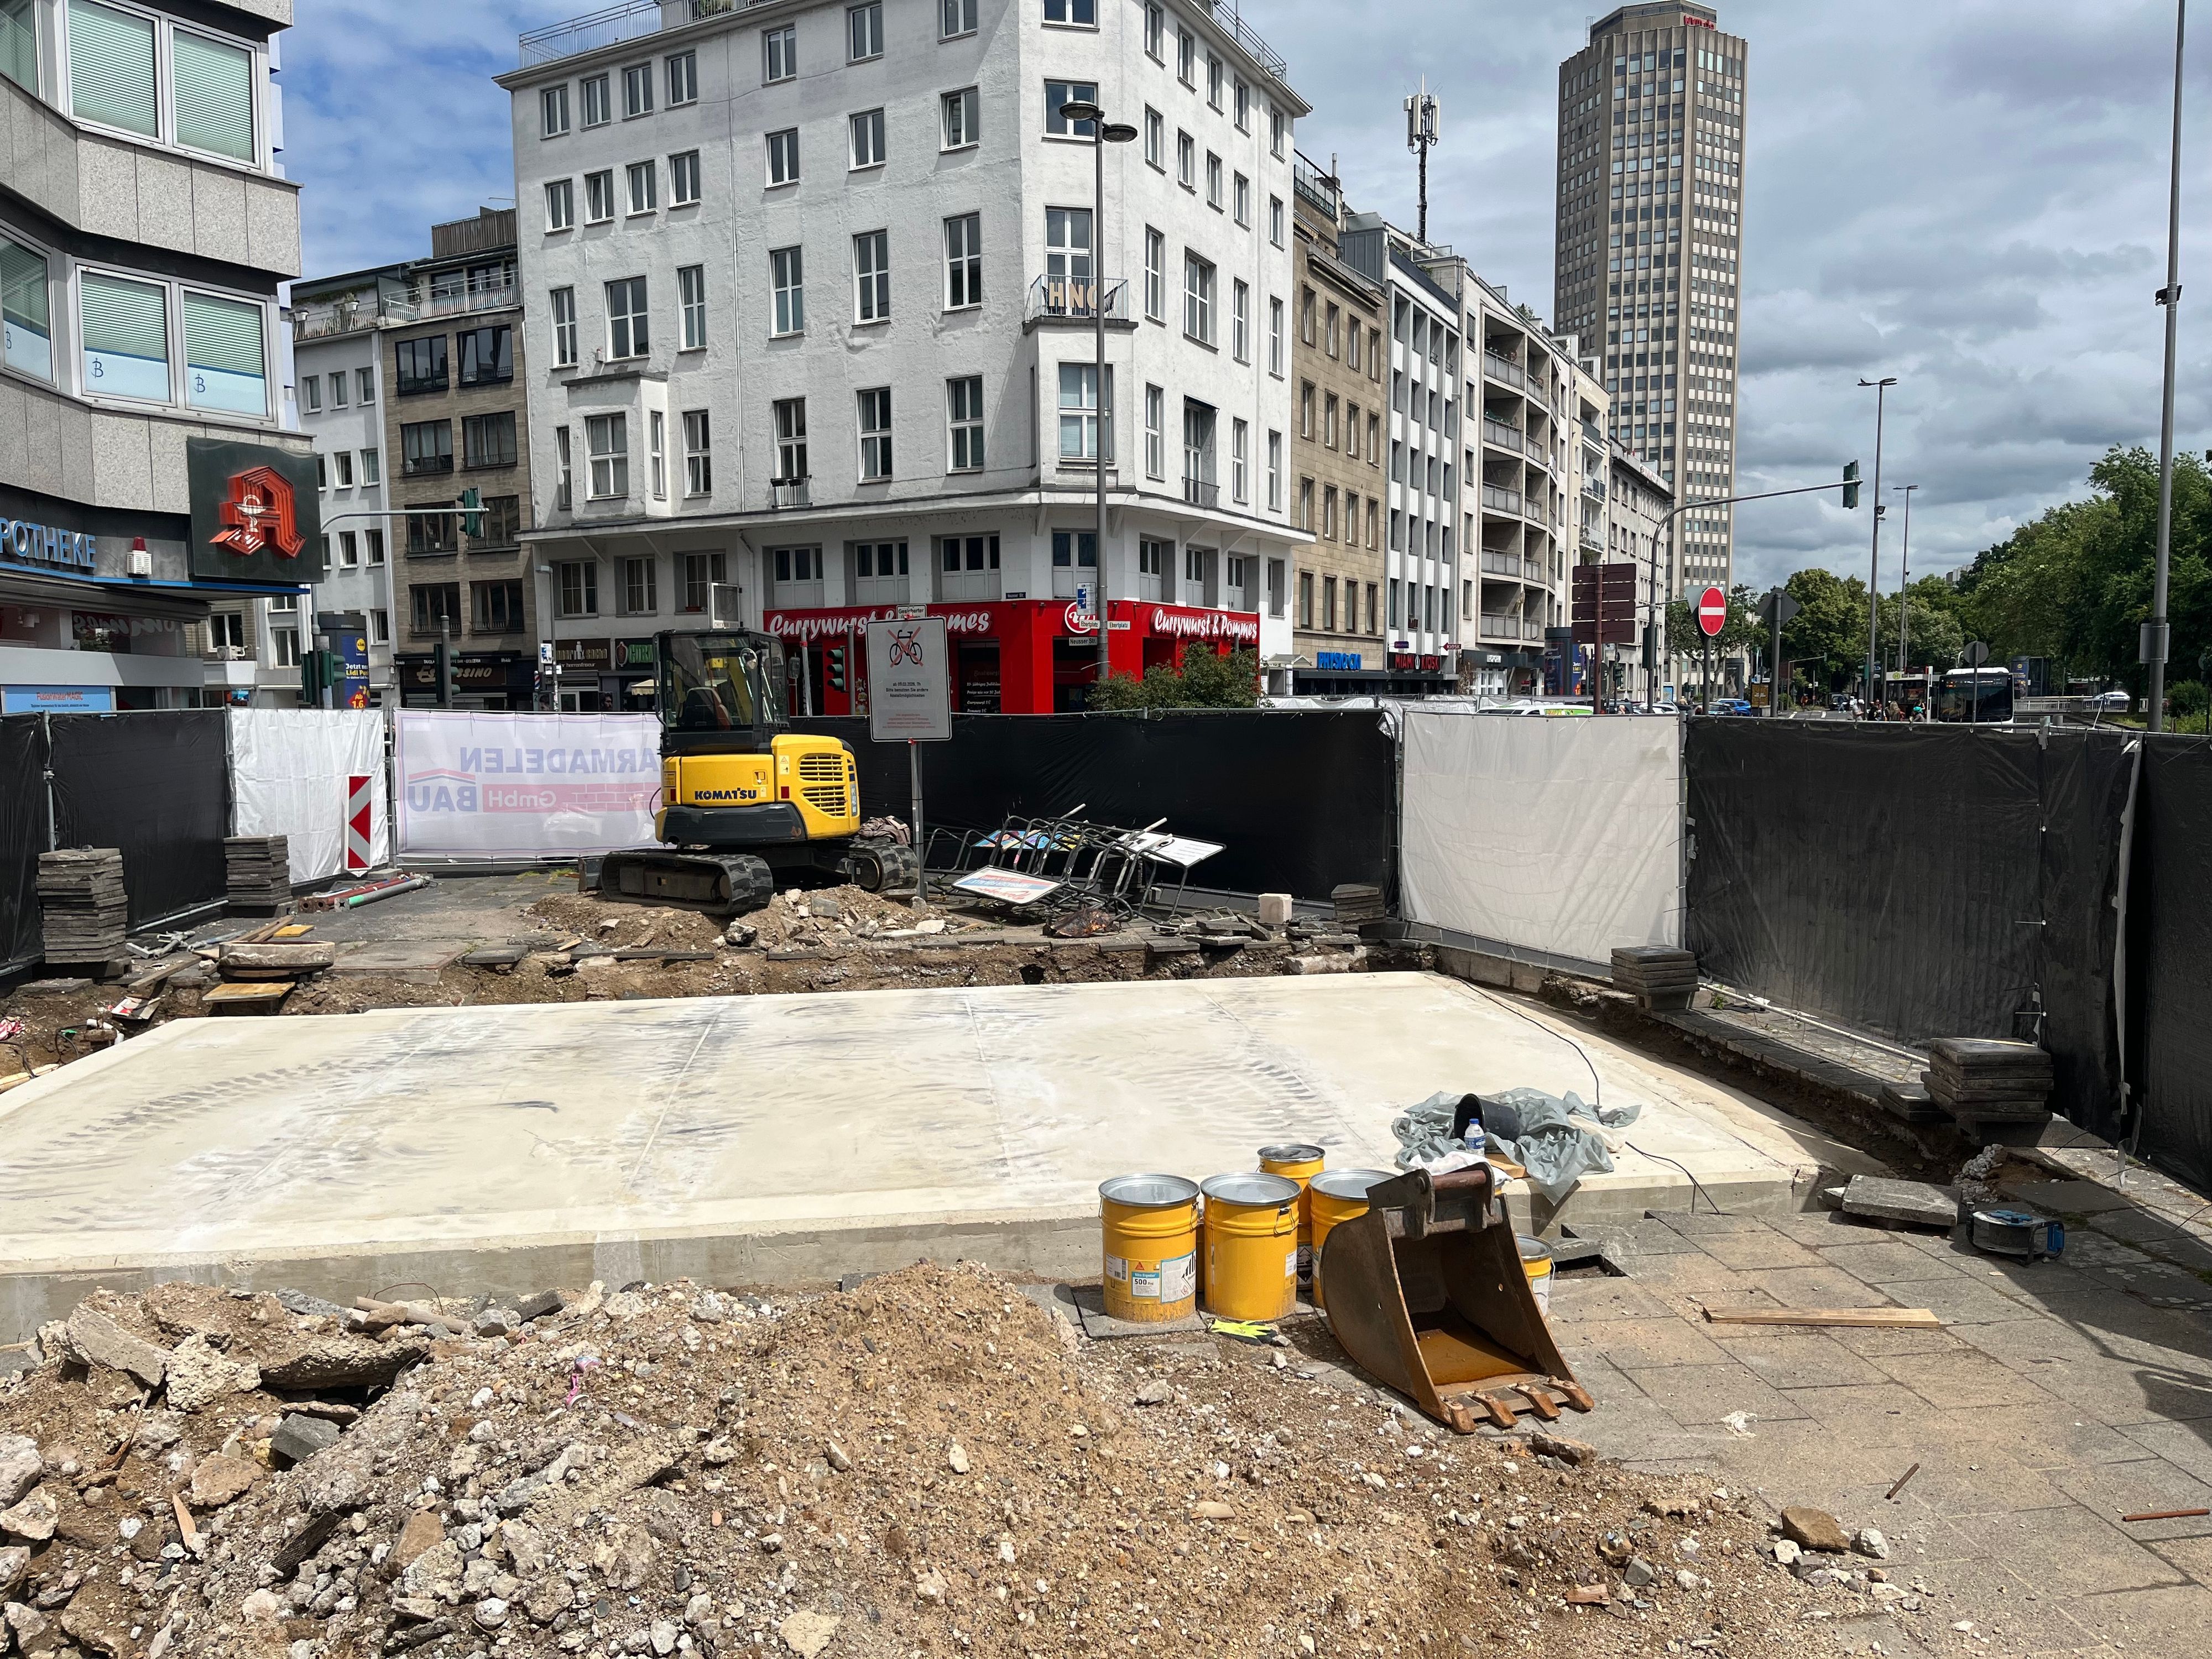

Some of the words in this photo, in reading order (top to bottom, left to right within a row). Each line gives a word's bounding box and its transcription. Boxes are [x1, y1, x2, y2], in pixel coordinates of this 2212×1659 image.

[1155, 609, 1211, 637] Currywurst
[1212, 615, 1220, 635] &
[1221, 614, 1258, 639] Pommes
[1395, 654, 1414, 669] MIAMI
[1421, 655, 1439, 670] KIOSK
[695, 787, 757, 800] KOMATSU
